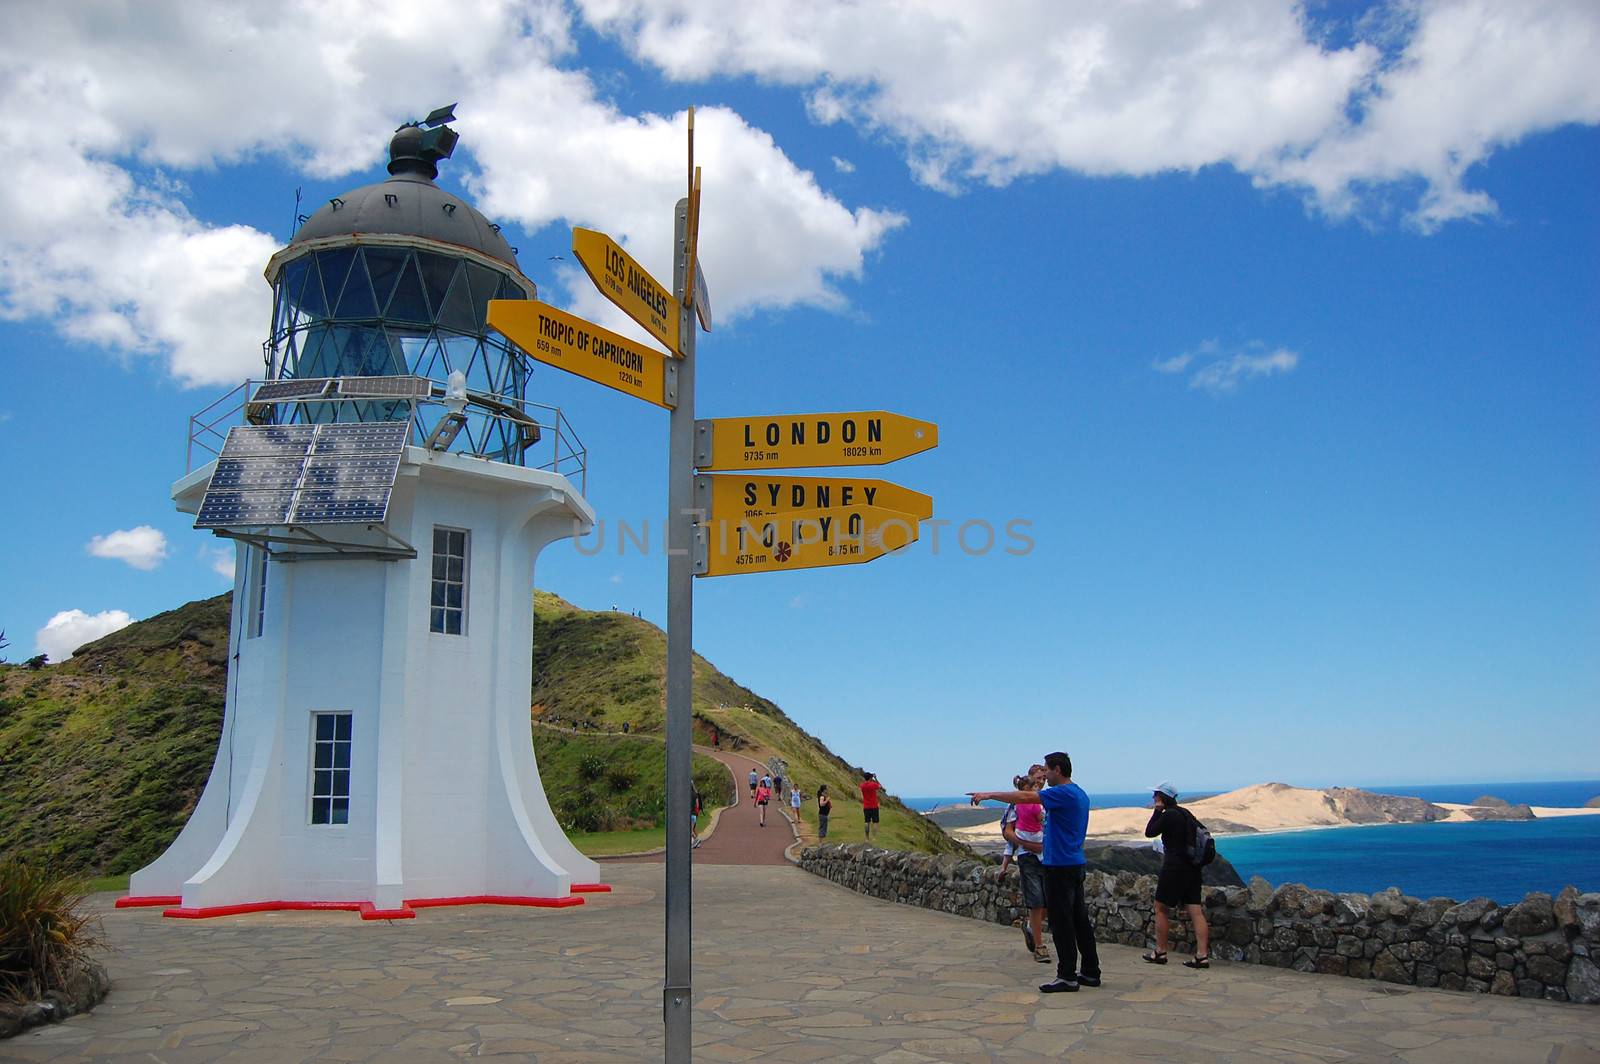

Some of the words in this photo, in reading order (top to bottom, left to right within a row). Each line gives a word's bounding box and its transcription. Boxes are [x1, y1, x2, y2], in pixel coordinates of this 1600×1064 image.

[605, 245, 625, 282] LOS
[627, 266, 667, 319] ANGELES
[536, 338, 550, 353] 659
[550, 346, 562, 357] nm
[538, 314, 574, 347] TROPIC
[577, 331, 589, 352] OF
[592, 337, 643, 374] CAPRICORN
[618, 371, 633, 384] 1220
[633, 376, 643, 388] km
[744, 419, 882, 447] LONDON
[744, 451, 764, 461] 9735
[766, 452, 779, 460] nm
[843, 447, 867, 457] 18029
[868, 447, 882, 456] km
[744, 482, 877, 508] SYDNEY
[736, 513, 862, 551] TOKYO
[736, 555, 754, 565] 4576
[755, 554, 767, 563] nm
[828, 544, 848, 556] 875
